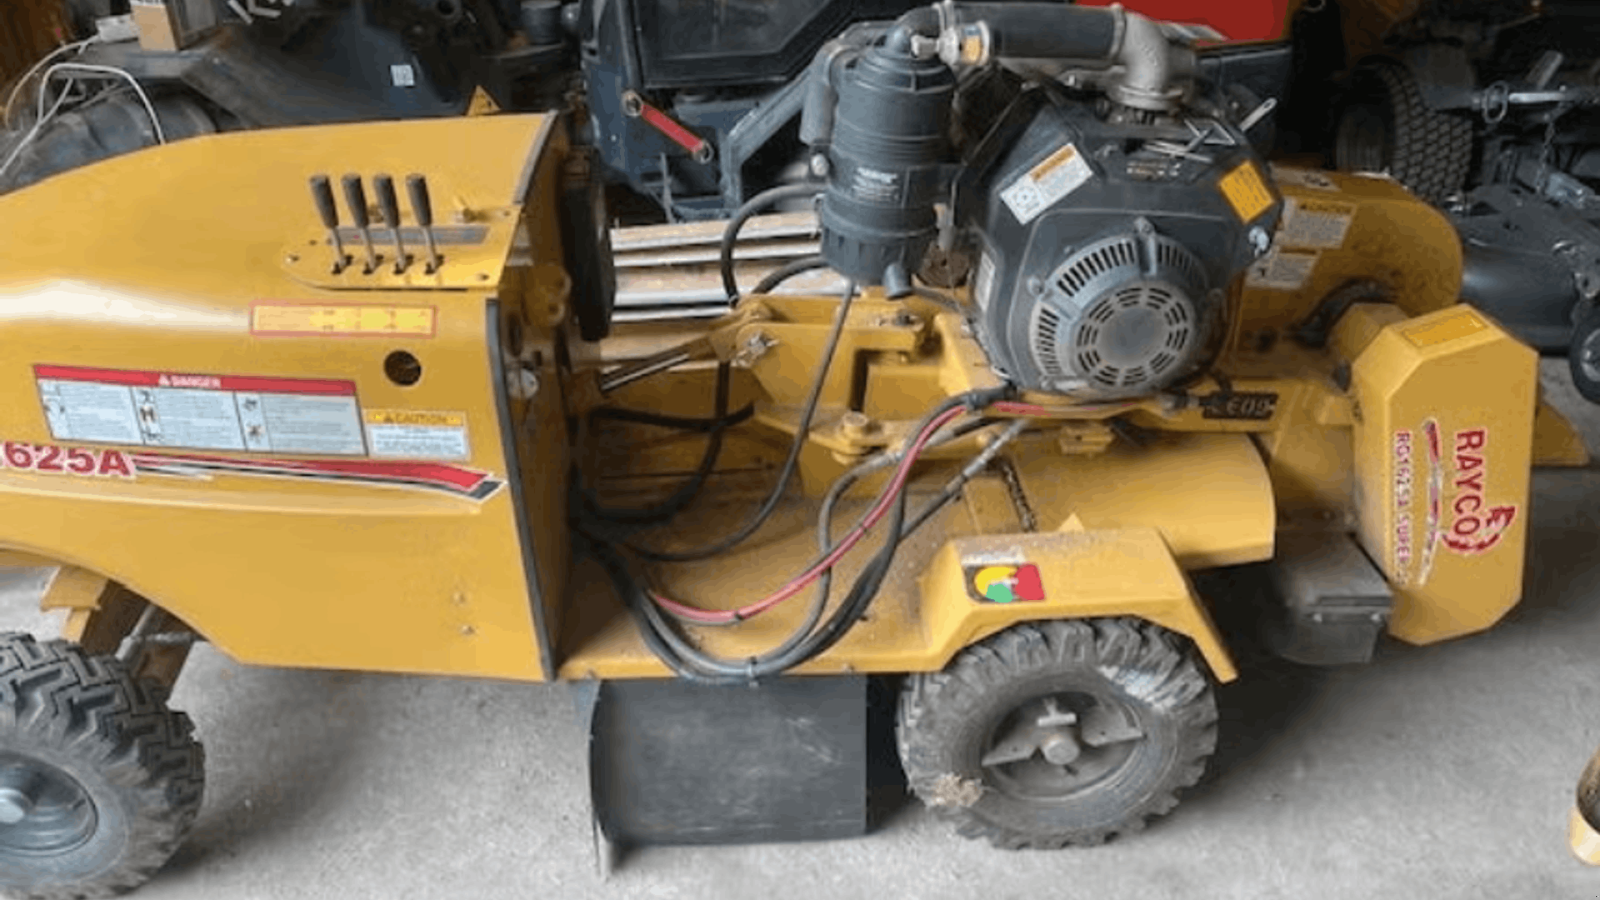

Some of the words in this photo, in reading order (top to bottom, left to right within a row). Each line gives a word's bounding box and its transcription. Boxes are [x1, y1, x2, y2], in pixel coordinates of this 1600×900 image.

[171, 375, 221, 389] DANGER
[395, 413, 447, 424] CAUTION
[1453, 429, 1487, 536] RAYCO
